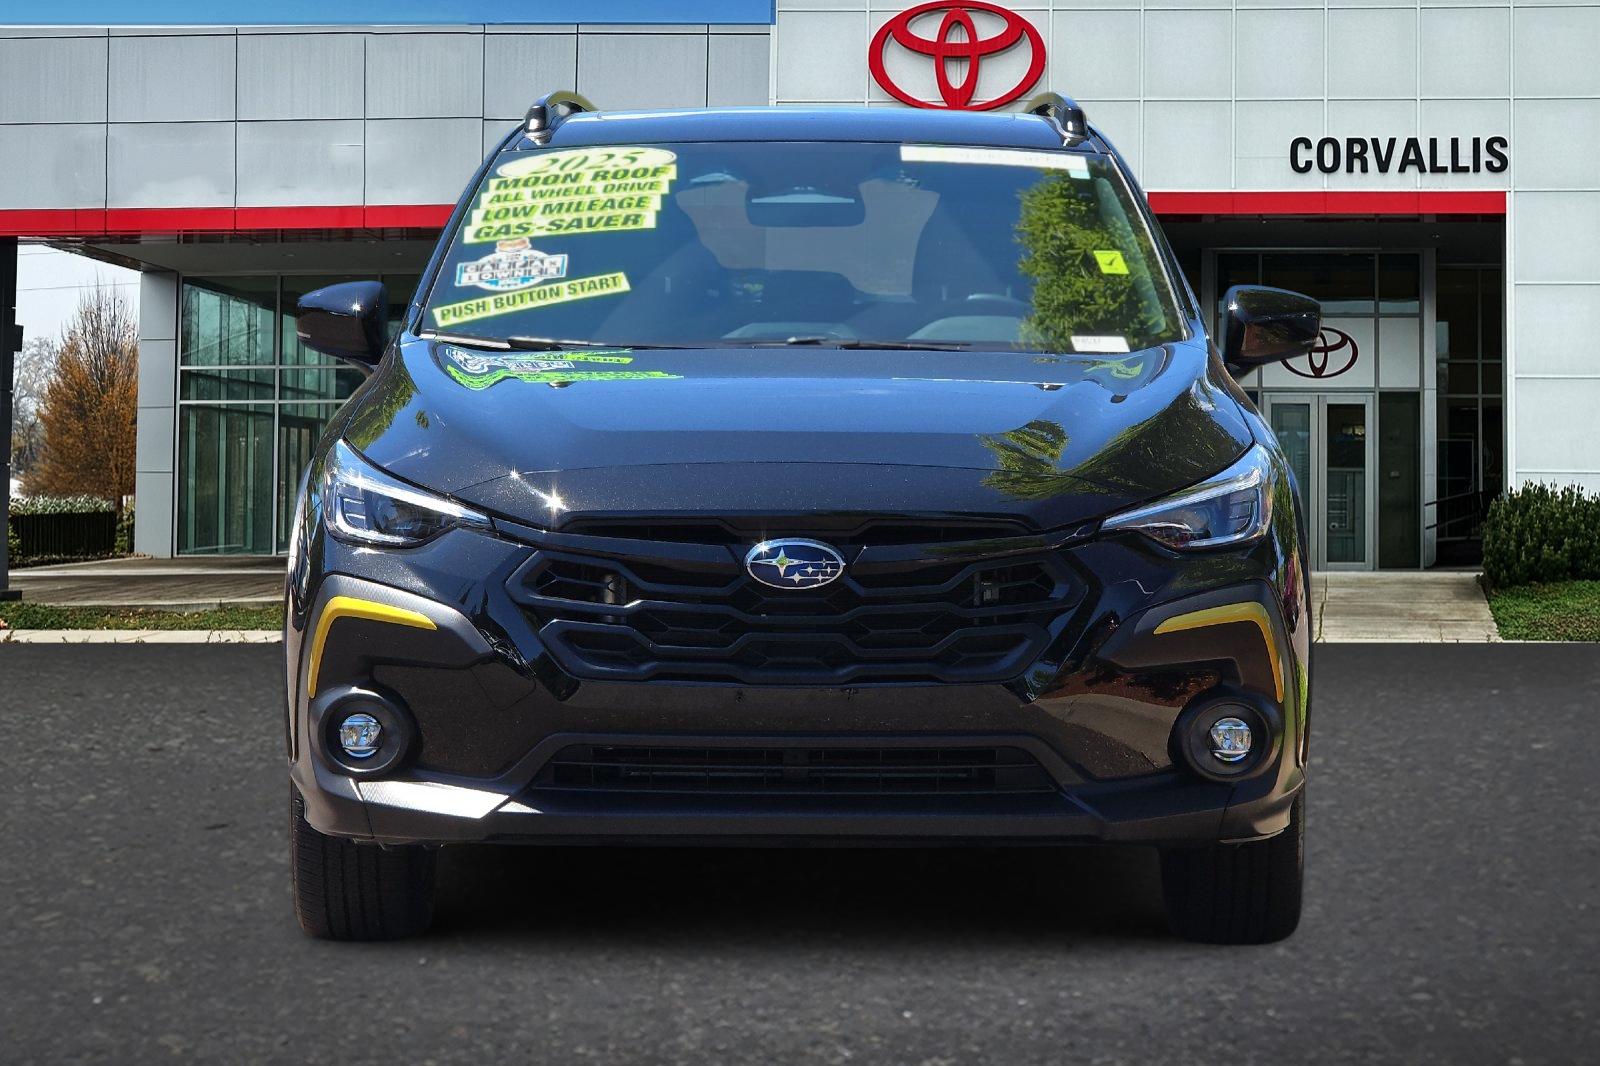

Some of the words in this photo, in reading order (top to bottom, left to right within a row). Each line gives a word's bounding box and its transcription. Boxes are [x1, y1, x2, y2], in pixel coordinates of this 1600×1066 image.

[529, 151, 645, 175] 2025
[1290, 136, 1509, 173] CORVALLIS
[495, 172, 582, 191] MOON
[591, 166, 671, 182] ROOF
[488, 191, 524, 204] ALL
[530, 186, 597, 200] WHEEL
[602, 180, 663, 194] DRIVE
[482, 204, 535, 222] LOW
[541, 196, 651, 216] MILEAGE
[473, 213, 645, 240] GAS-SAVER
[440, 300, 488, 321] PUSH
[493, 287, 562, 310] BUTTON
[568, 276, 621, 295] START
